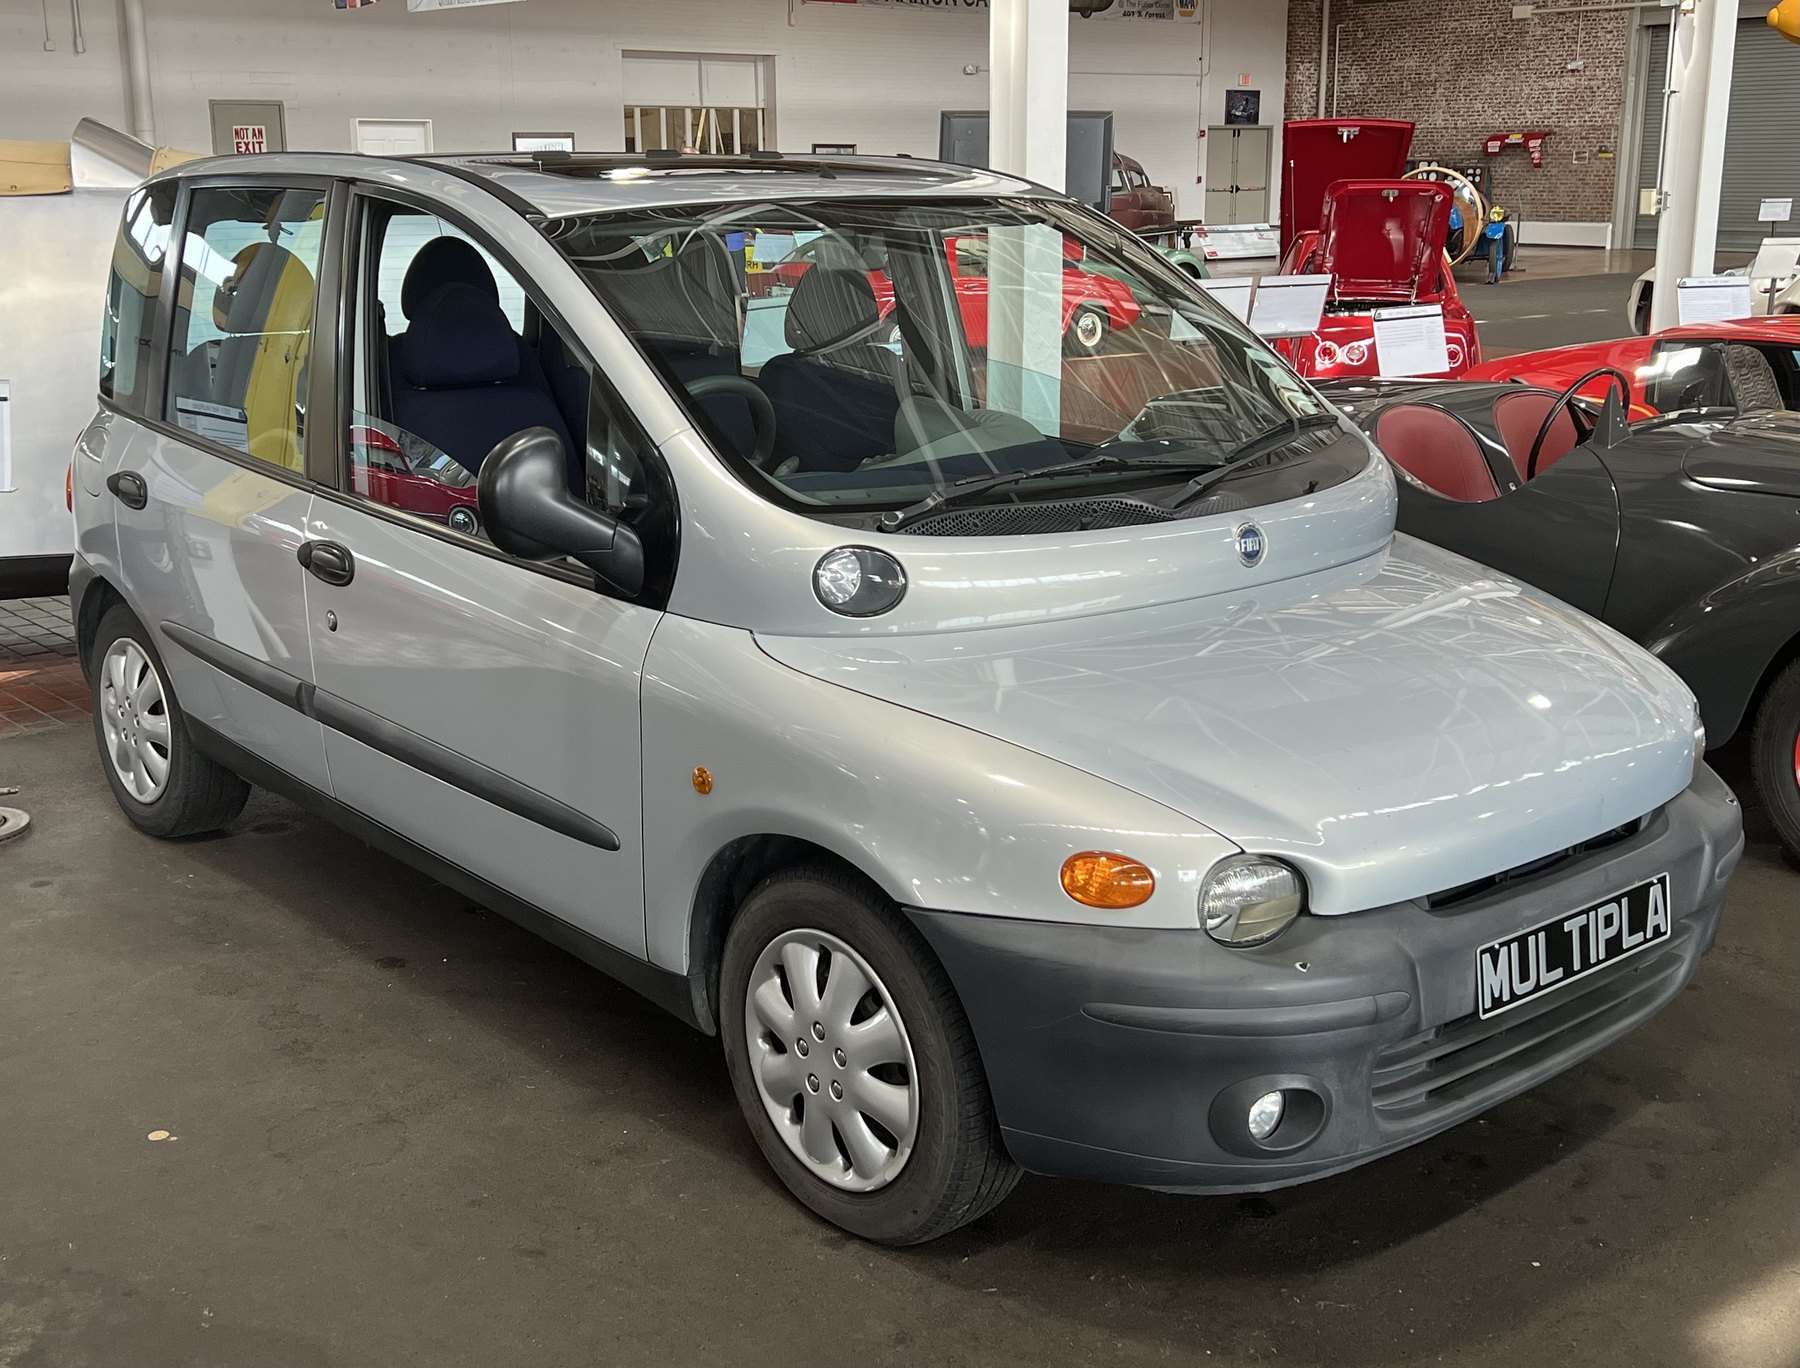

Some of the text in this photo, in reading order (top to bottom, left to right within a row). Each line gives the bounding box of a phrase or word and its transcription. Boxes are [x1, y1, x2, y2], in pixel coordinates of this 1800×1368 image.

[234, 127, 263, 140] NOT AN
[235, 141, 264, 153] EXIT
[1240, 537, 1260, 552] FIAT
[1481, 883, 1667, 1010] MULTIPLA
